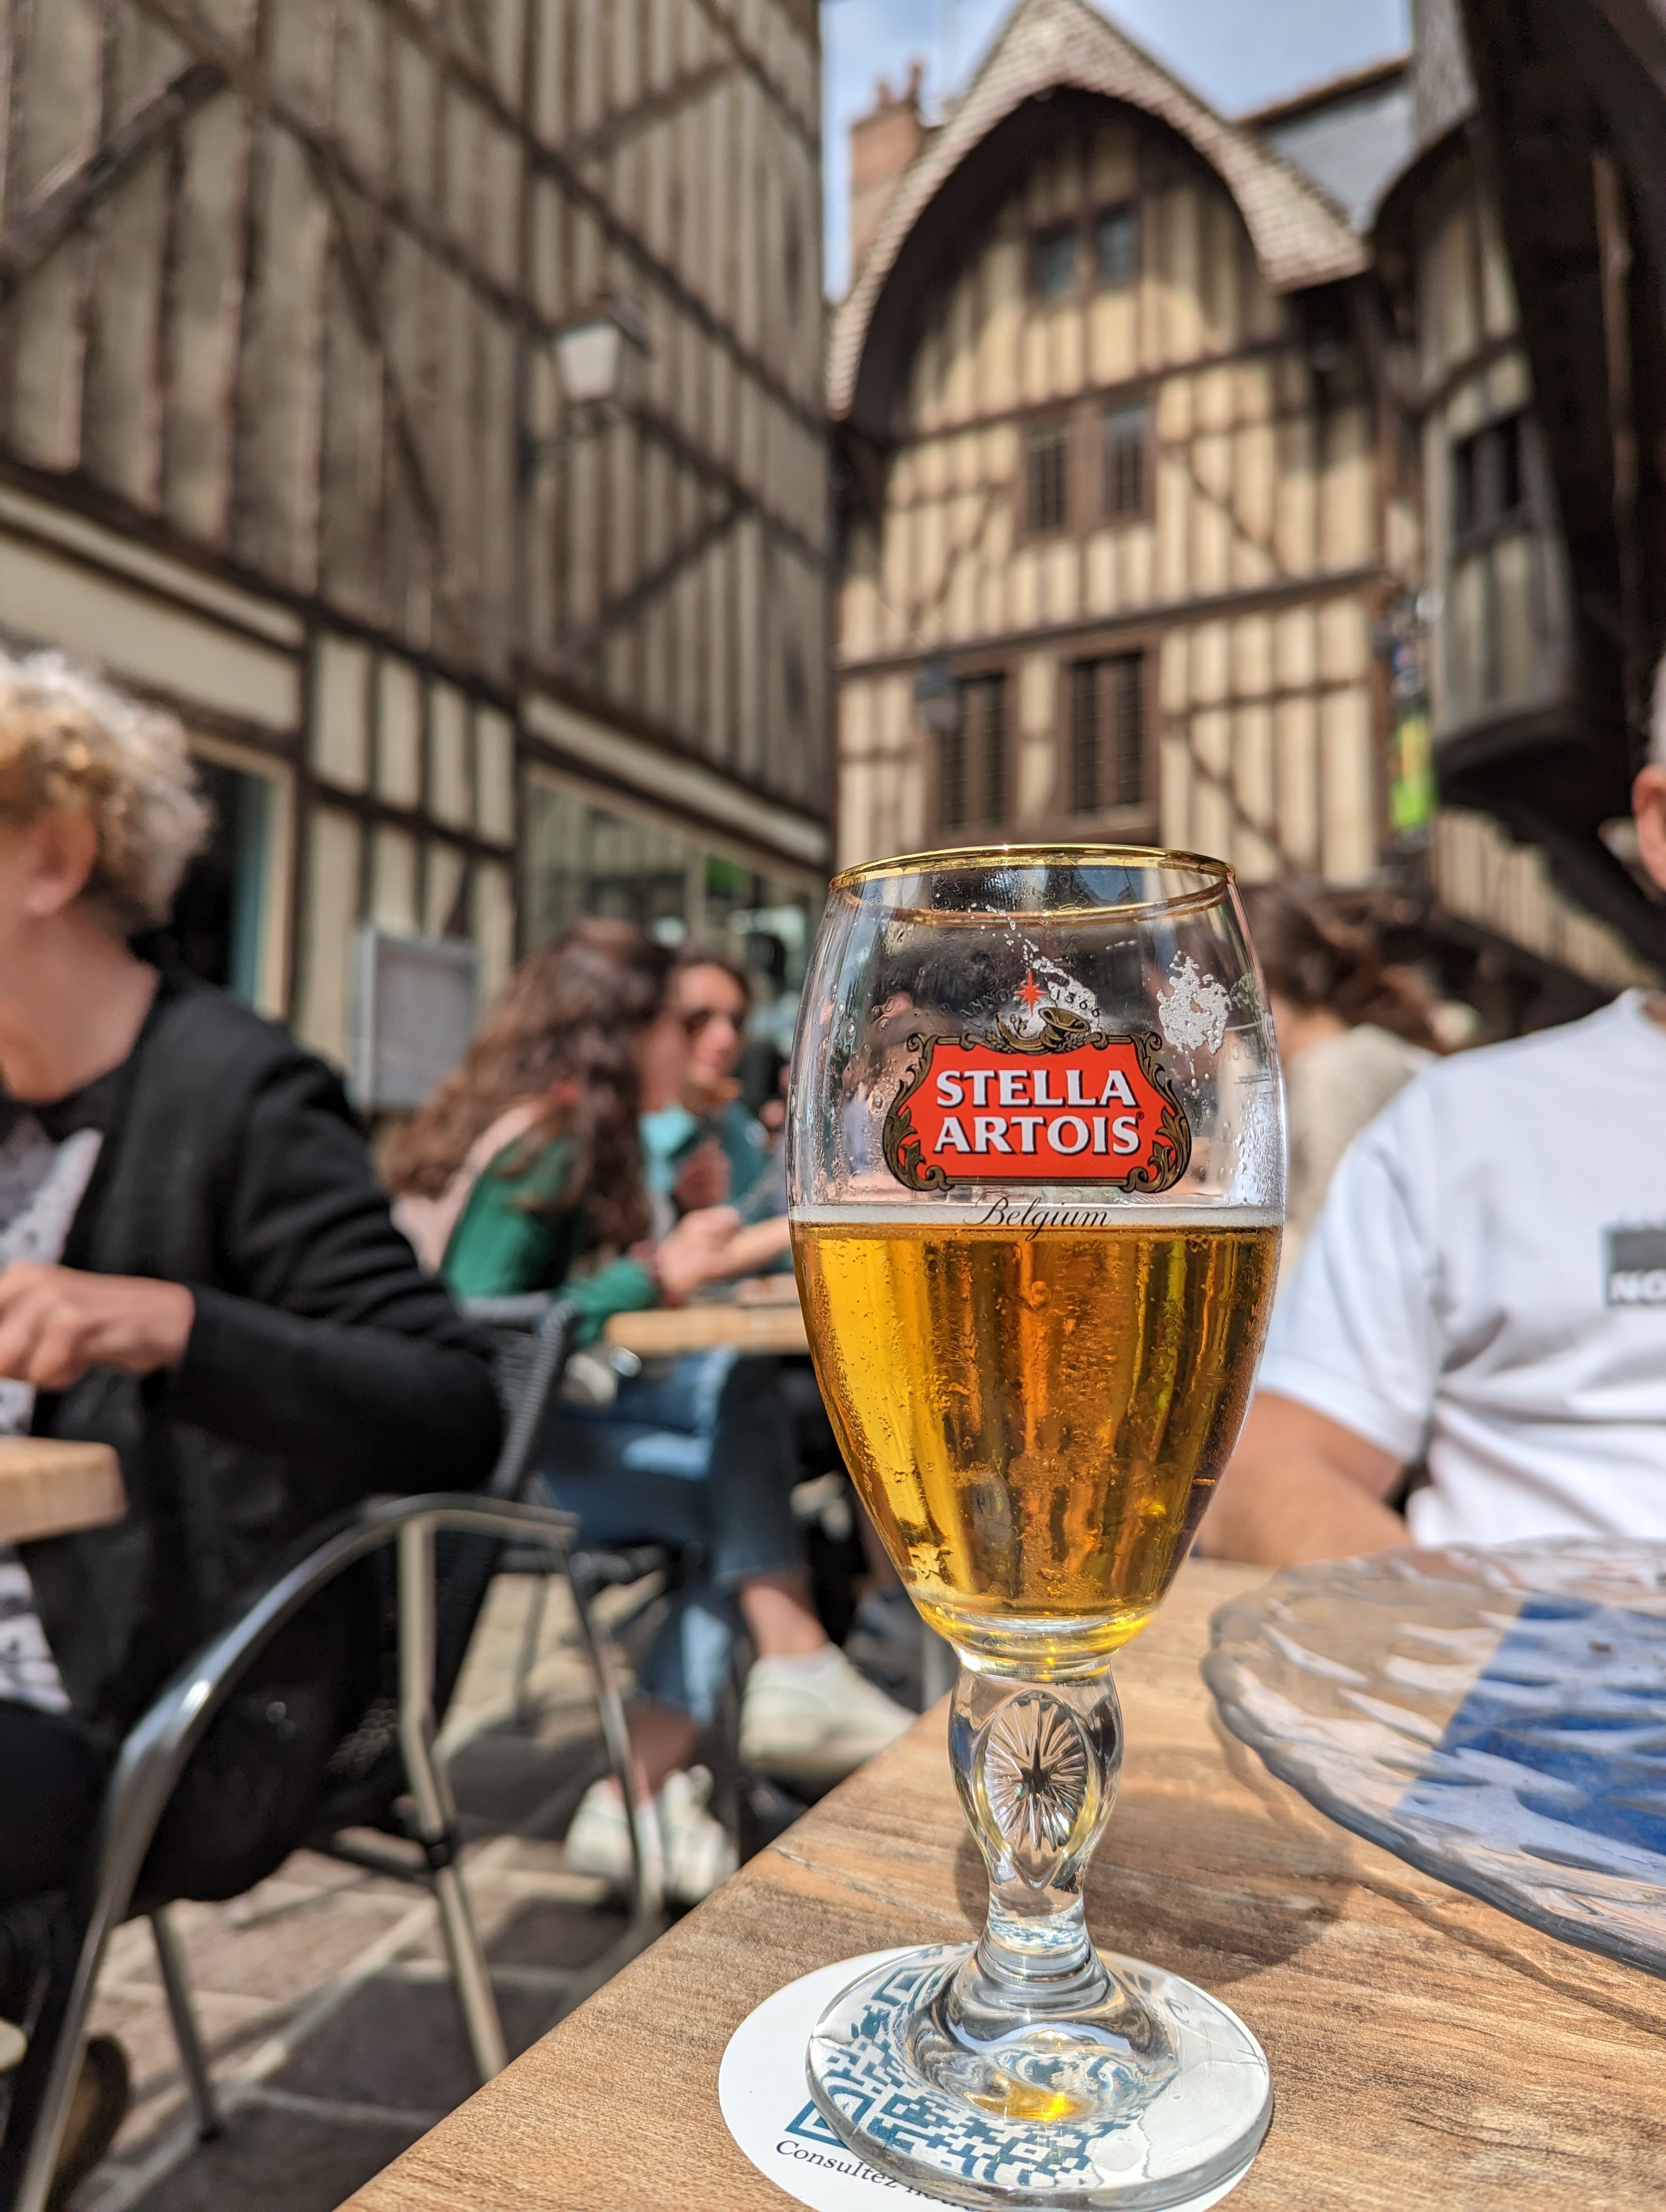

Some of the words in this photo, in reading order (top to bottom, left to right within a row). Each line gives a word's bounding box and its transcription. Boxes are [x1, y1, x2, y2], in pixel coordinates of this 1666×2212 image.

[1054, 989, 1101, 1018] 1366
[935, 1069, 1140, 1108] STELLA
[933, 1115, 1139, 1155] ARTOIS
[963, 1194, 1111, 1241] Belgium
[776, 2139, 899, 2189] Consultez
